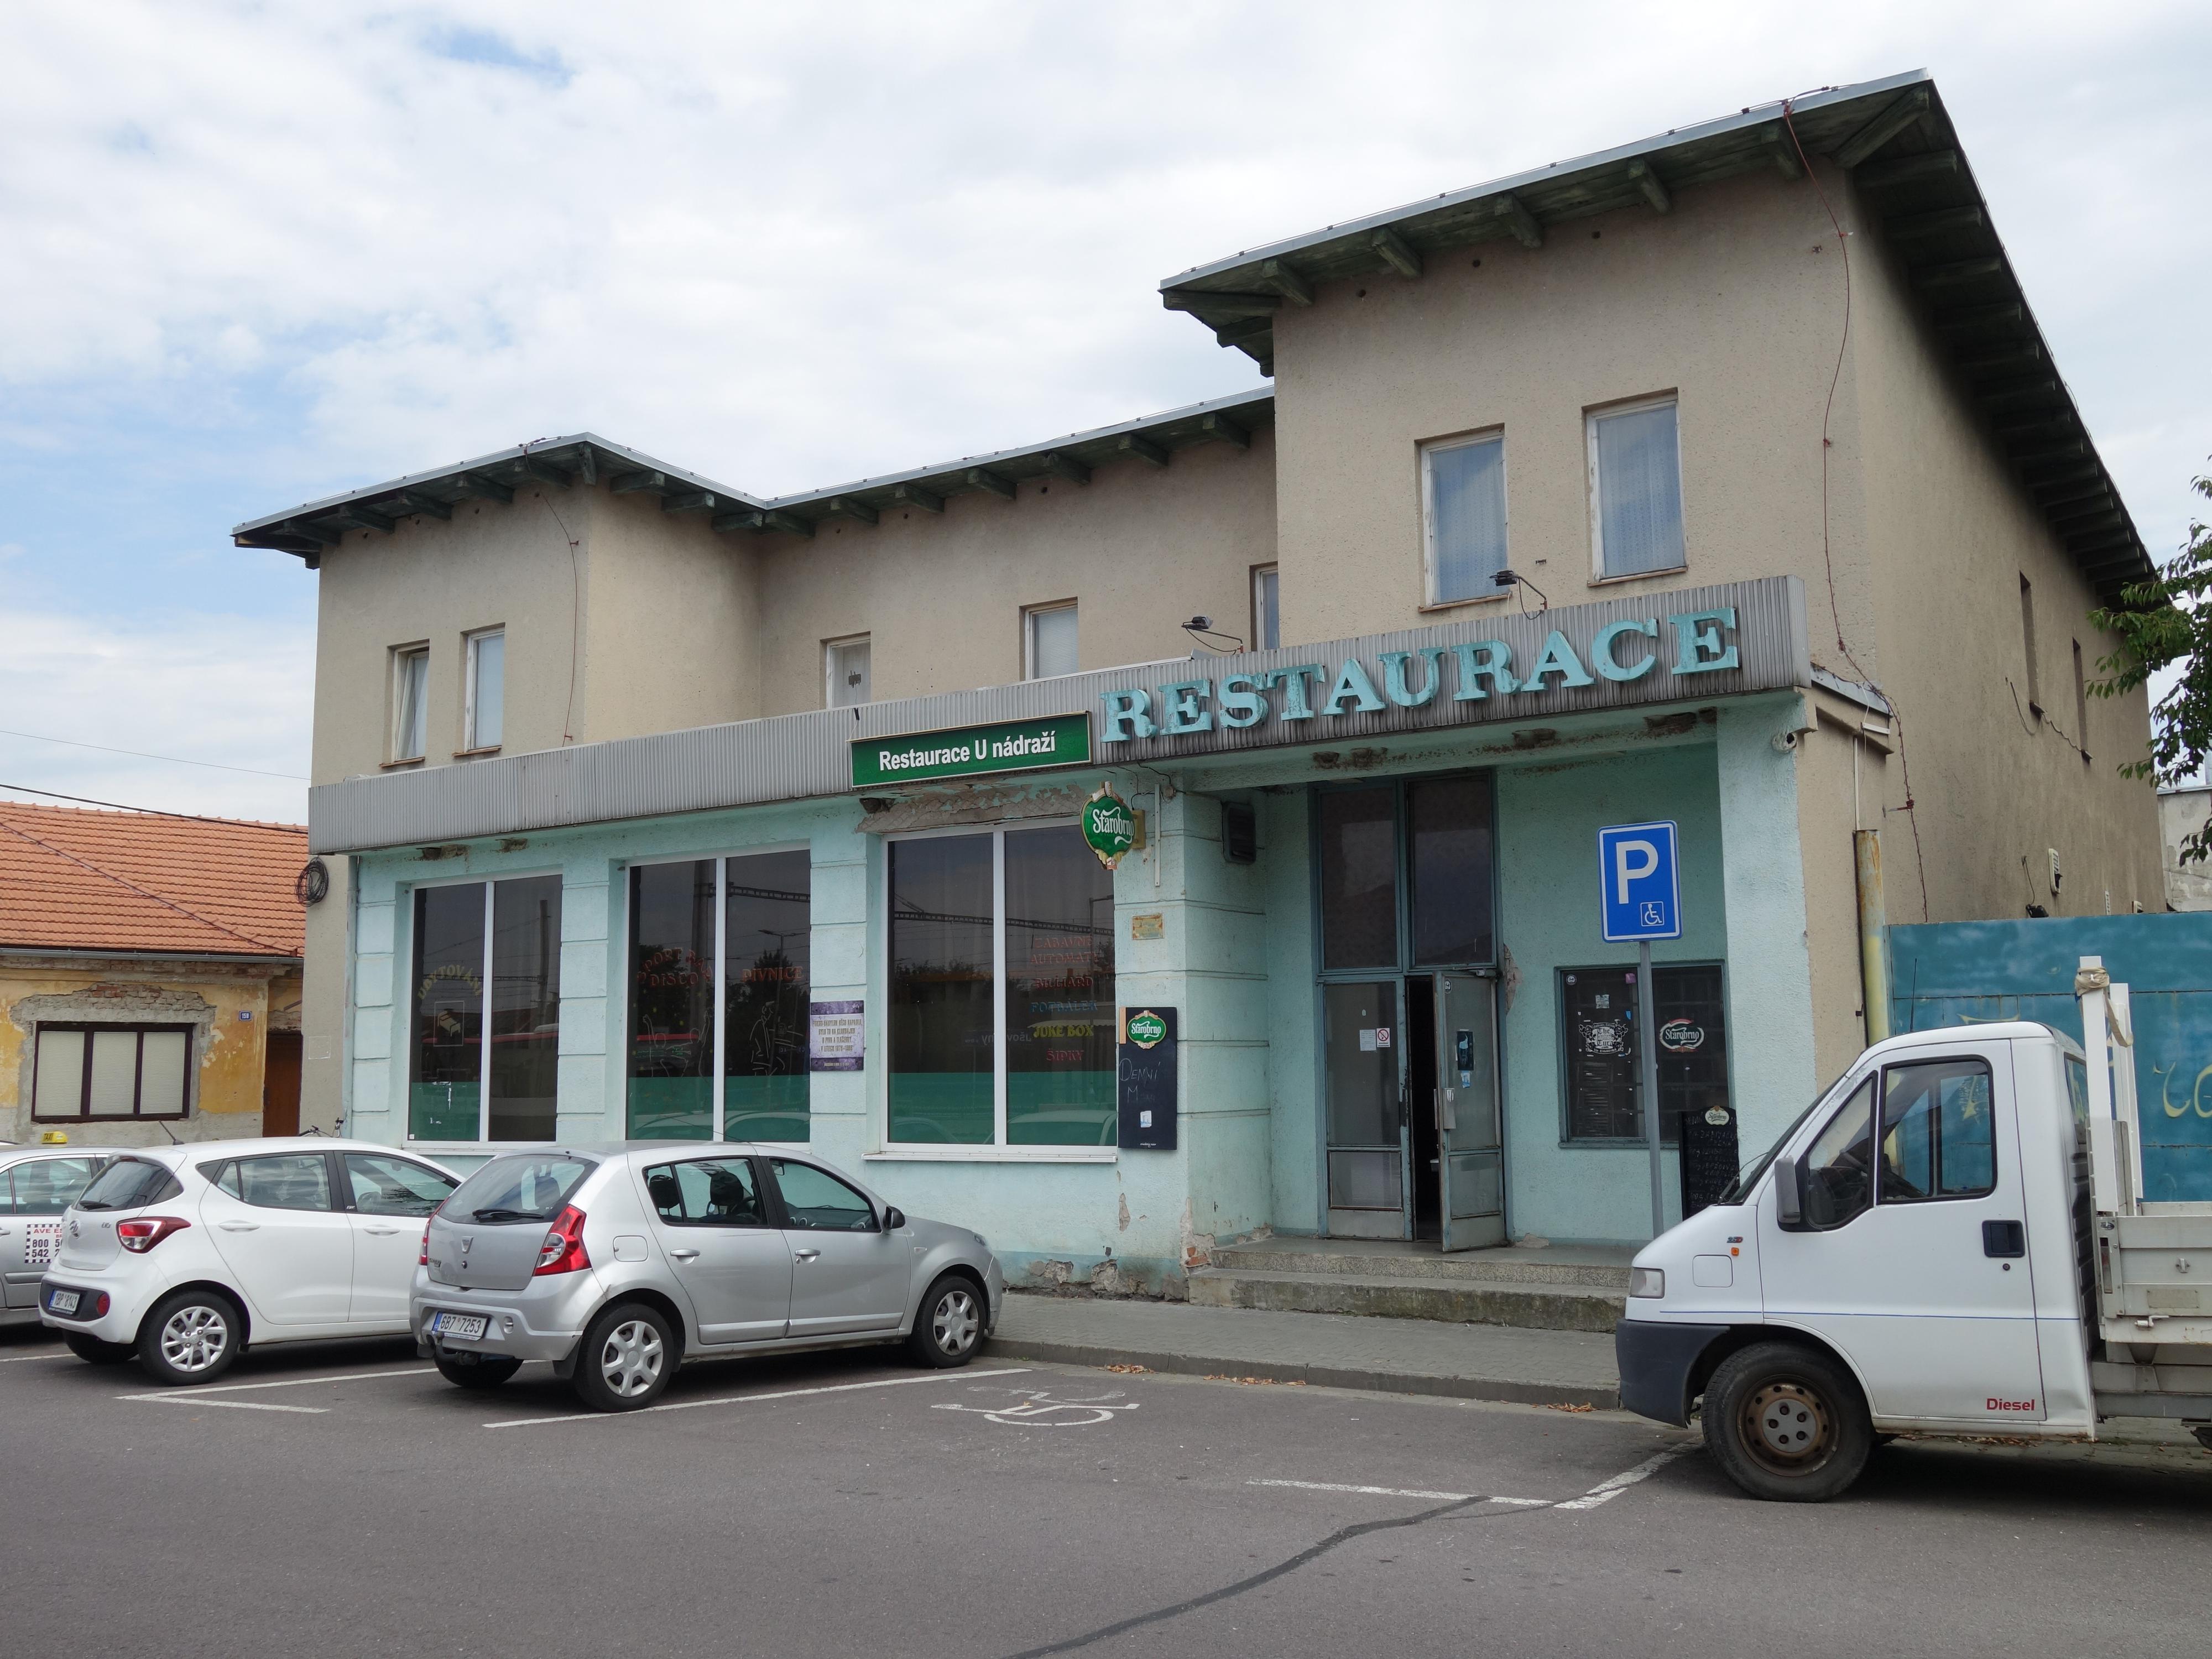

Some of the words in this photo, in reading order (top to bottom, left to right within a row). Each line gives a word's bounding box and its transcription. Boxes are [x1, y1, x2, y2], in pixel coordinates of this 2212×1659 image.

[1100, 607, 1741, 743] RESTAURACE
[879, 747, 971, 771] Restaurace
[975, 739, 987, 760] U
[992, 730, 1056, 758] nádraží
[1092, 806, 1134, 846] Starobrno
[1615, 839, 1658, 905] P
[742, 966, 803, 983] PIVNICE
[1033, 1025, 1064, 1037] JUKE
[1067, 1025, 1094, 1037] BOX
[1131, 1021, 1161, 1039] Starobrno
[1665, 1027, 1699, 1045] Starobrno
[1046, 1048, 1084, 1062] ŠIPKY
[44, 1133, 54, 1141] TAXI
[32, 1239, 49, 1248] 800
[32, 1249, 49, 1258] 542
[440, 1315, 457, 1330] 6B7
[459, 1317, 482, 1333] 7253
[1986, 1398, 2035, 1411] Diesel
